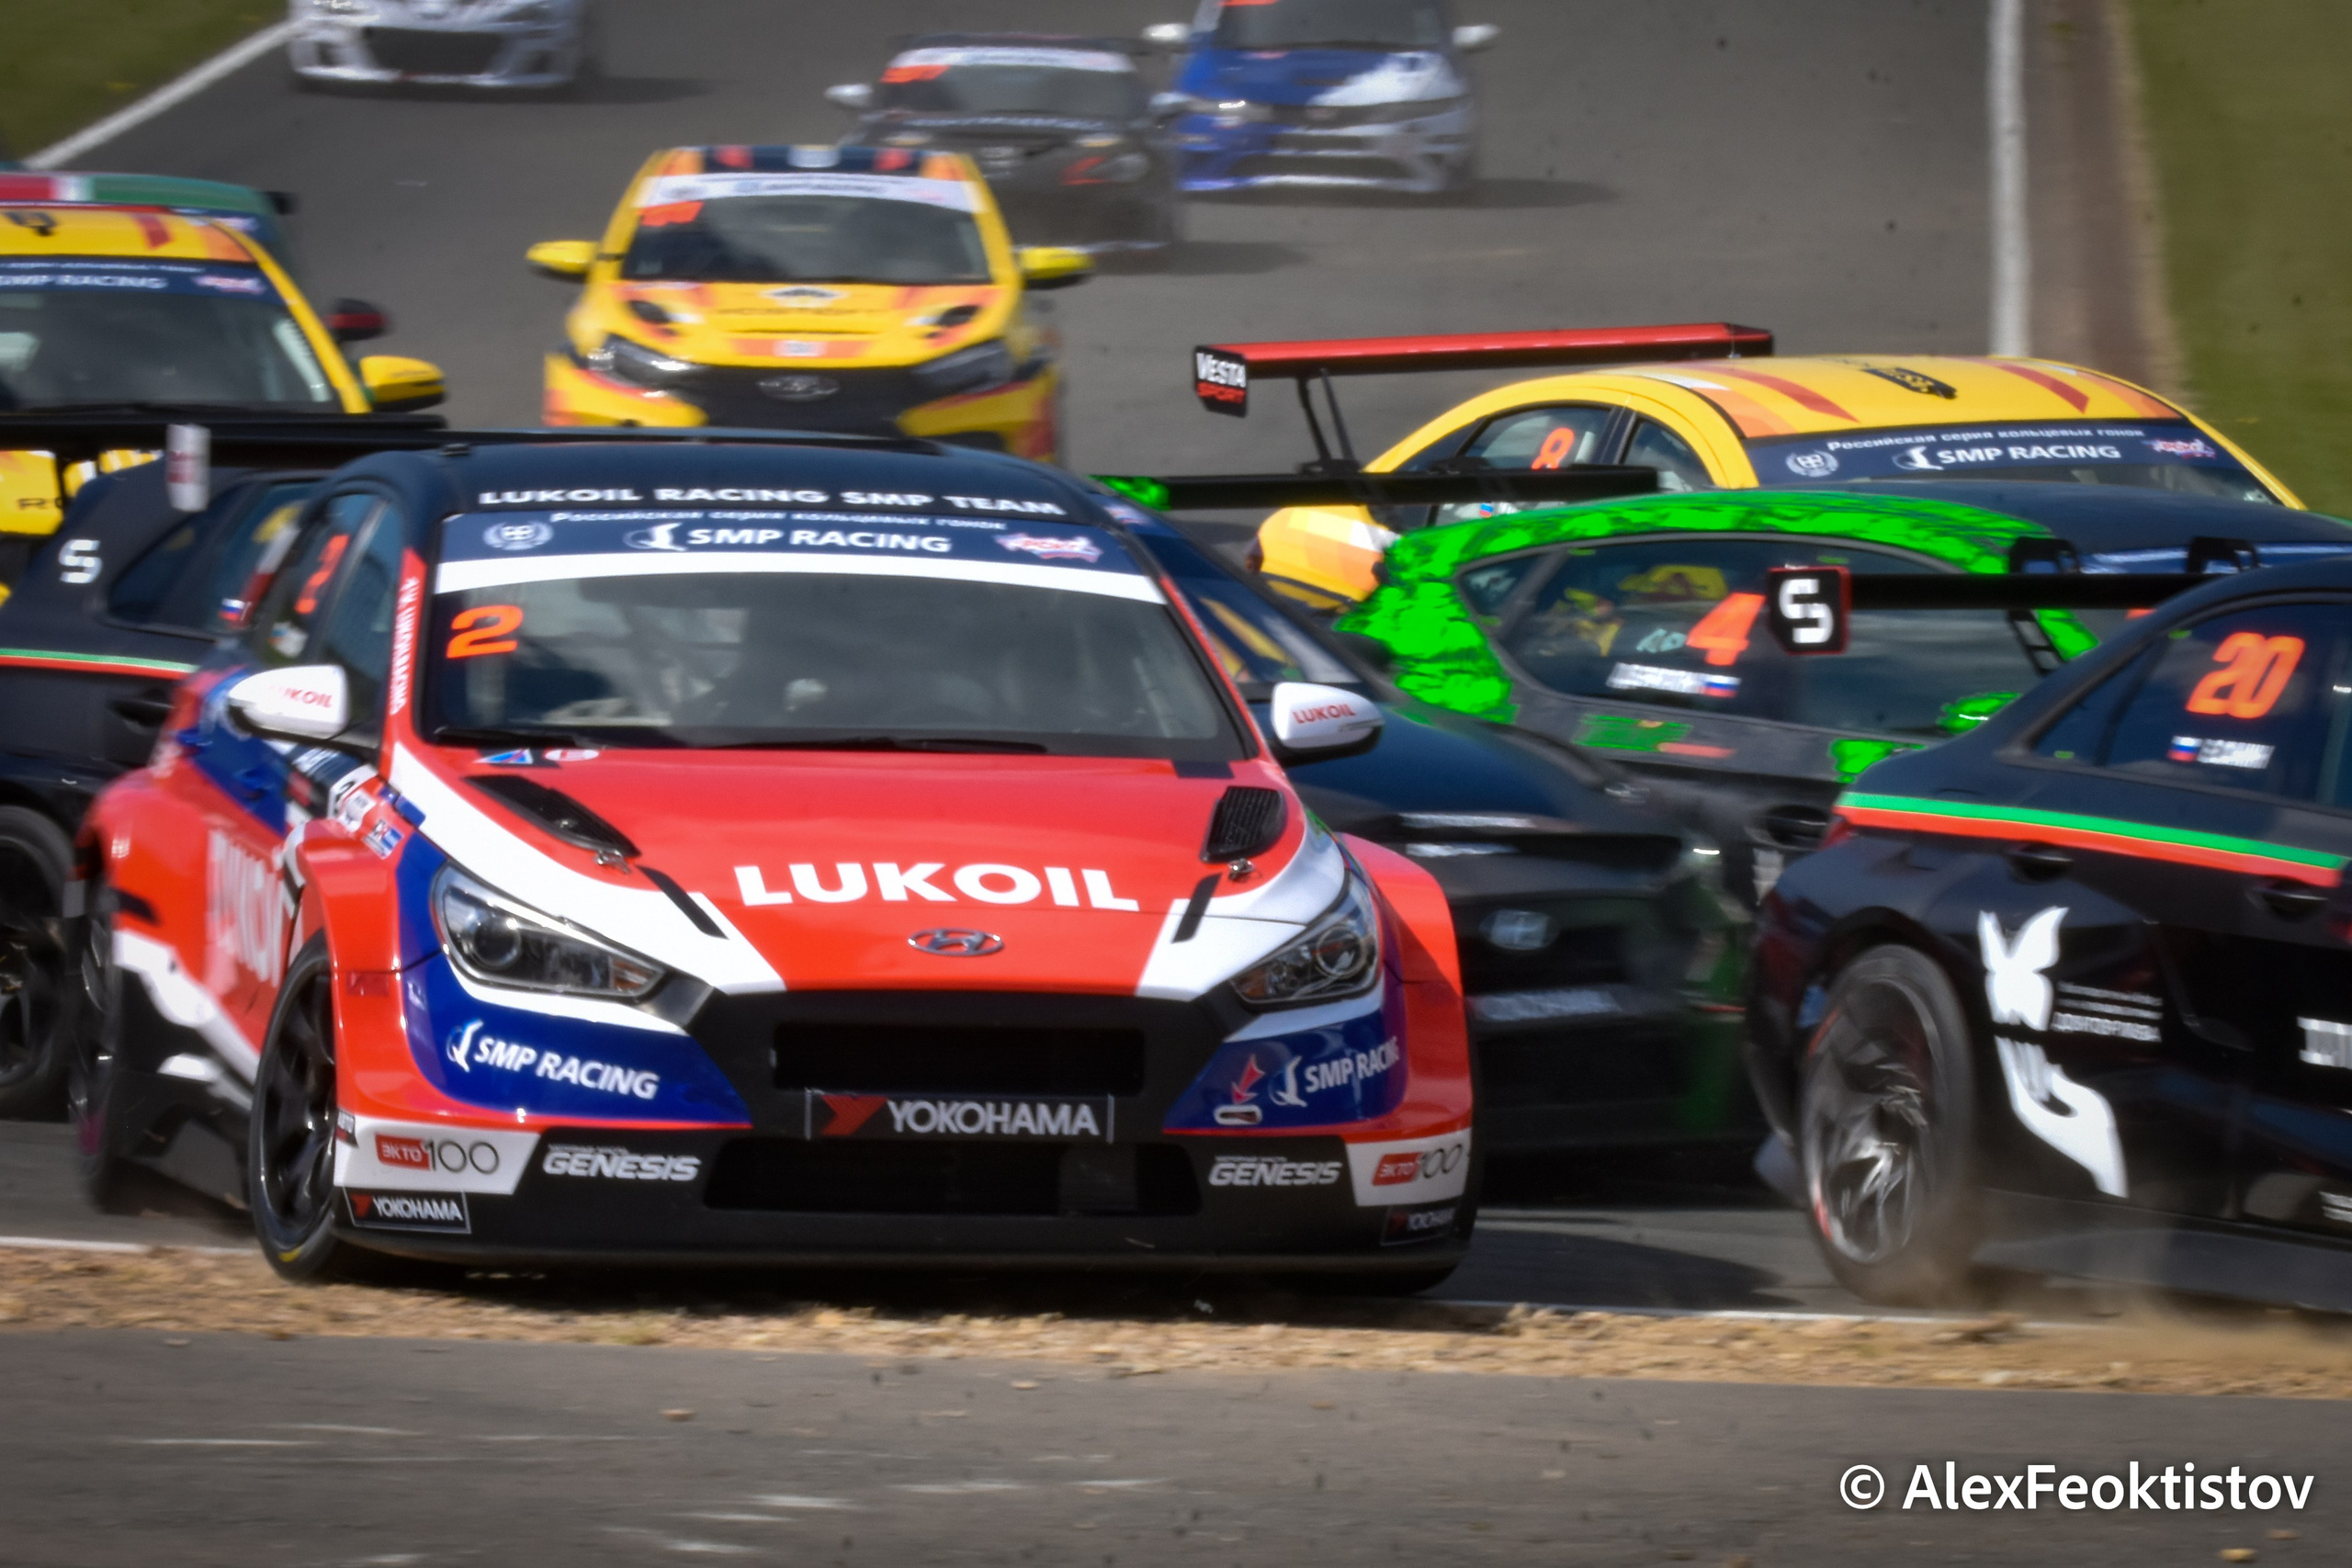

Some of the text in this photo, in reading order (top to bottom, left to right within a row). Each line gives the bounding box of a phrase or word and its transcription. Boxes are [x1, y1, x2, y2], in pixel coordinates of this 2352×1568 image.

[1196, 352, 1246, 388] VESTA
[1197, 381, 1246, 403] SPORT
[1937, 445, 2122, 464] SMP RACING
[479, 489, 1067, 515] LUKOIL RACING SMP TEAM
[687, 529, 952, 552] SMP RACING
[59, 539, 102, 583] S
[1779, 578, 1834, 644] S
[447, 604, 524, 659] 2
[1686, 592, 1767, 666] 4
[2185, 632, 2305, 718] 20
[1293, 704, 1356, 724] LUKOIL
[734, 863, 1140, 912] LUKOIL
[474, 1036, 660, 1100] SMP RACING
[1305, 1057, 1355, 1093] SMP
[887, 1100, 1100, 1135] YOKOHAMA
[543, 1152, 702, 1181] GENESIS
[1209, 1162, 1342, 1186] GENESIS
[372, 1197, 464, 1222] YOKOHAMA
